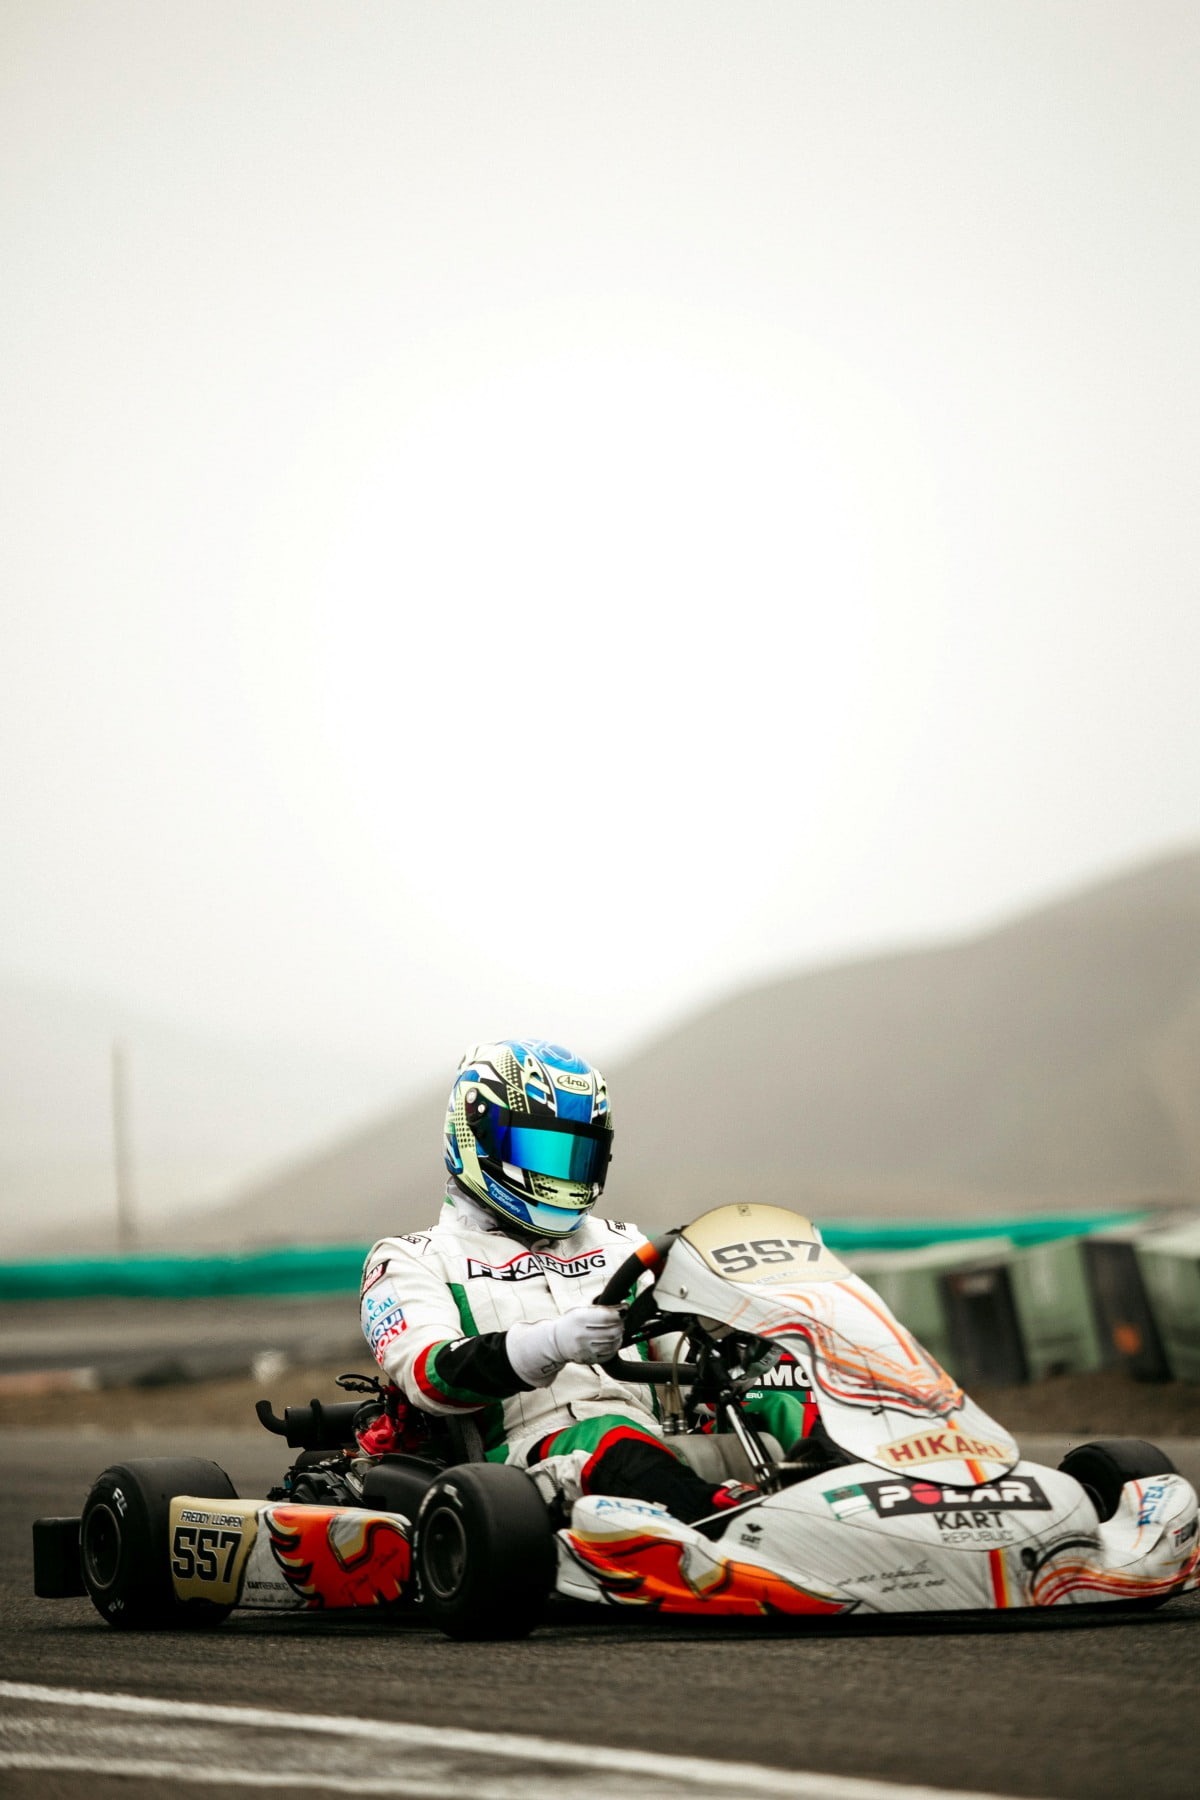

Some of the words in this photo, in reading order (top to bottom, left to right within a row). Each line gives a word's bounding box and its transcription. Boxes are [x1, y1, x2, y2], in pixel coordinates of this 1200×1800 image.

[564, 1075, 587, 1088] Arai
[372, 1308, 404, 1349] IQUI
[888, 1433, 1005, 1463] HIKARI
[180, 1511, 210, 1524] FREDDY
[934, 1511, 1004, 1530] KART
[940, 1530, 1015, 1545] REPUBLIC
